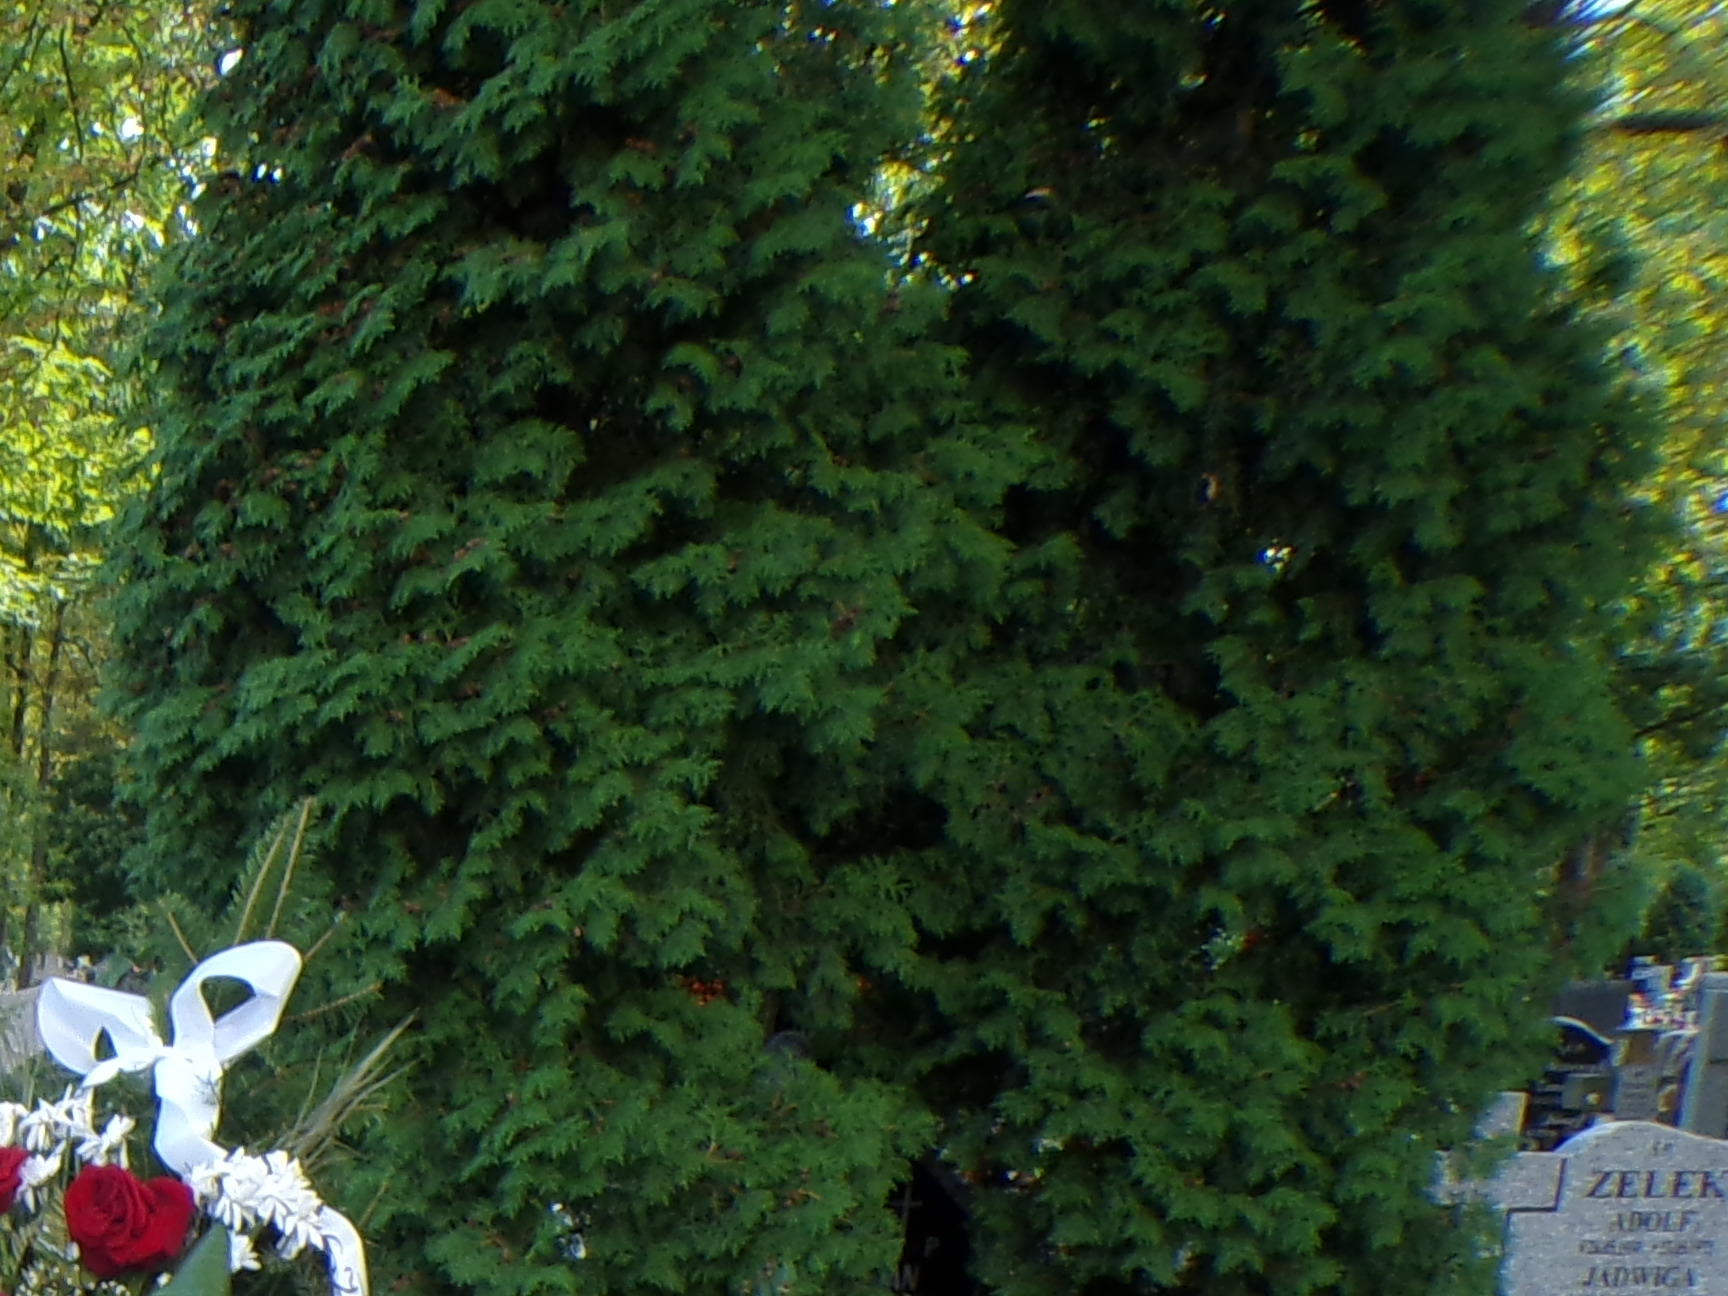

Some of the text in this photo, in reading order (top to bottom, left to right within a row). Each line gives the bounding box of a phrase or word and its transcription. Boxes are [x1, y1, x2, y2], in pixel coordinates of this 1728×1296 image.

[1582, 1169, 1728, 1199] ZELEK
[1609, 1209, 1700, 1233] ADOLF
[1581, 1265, 1696, 1288] JADWIGA
